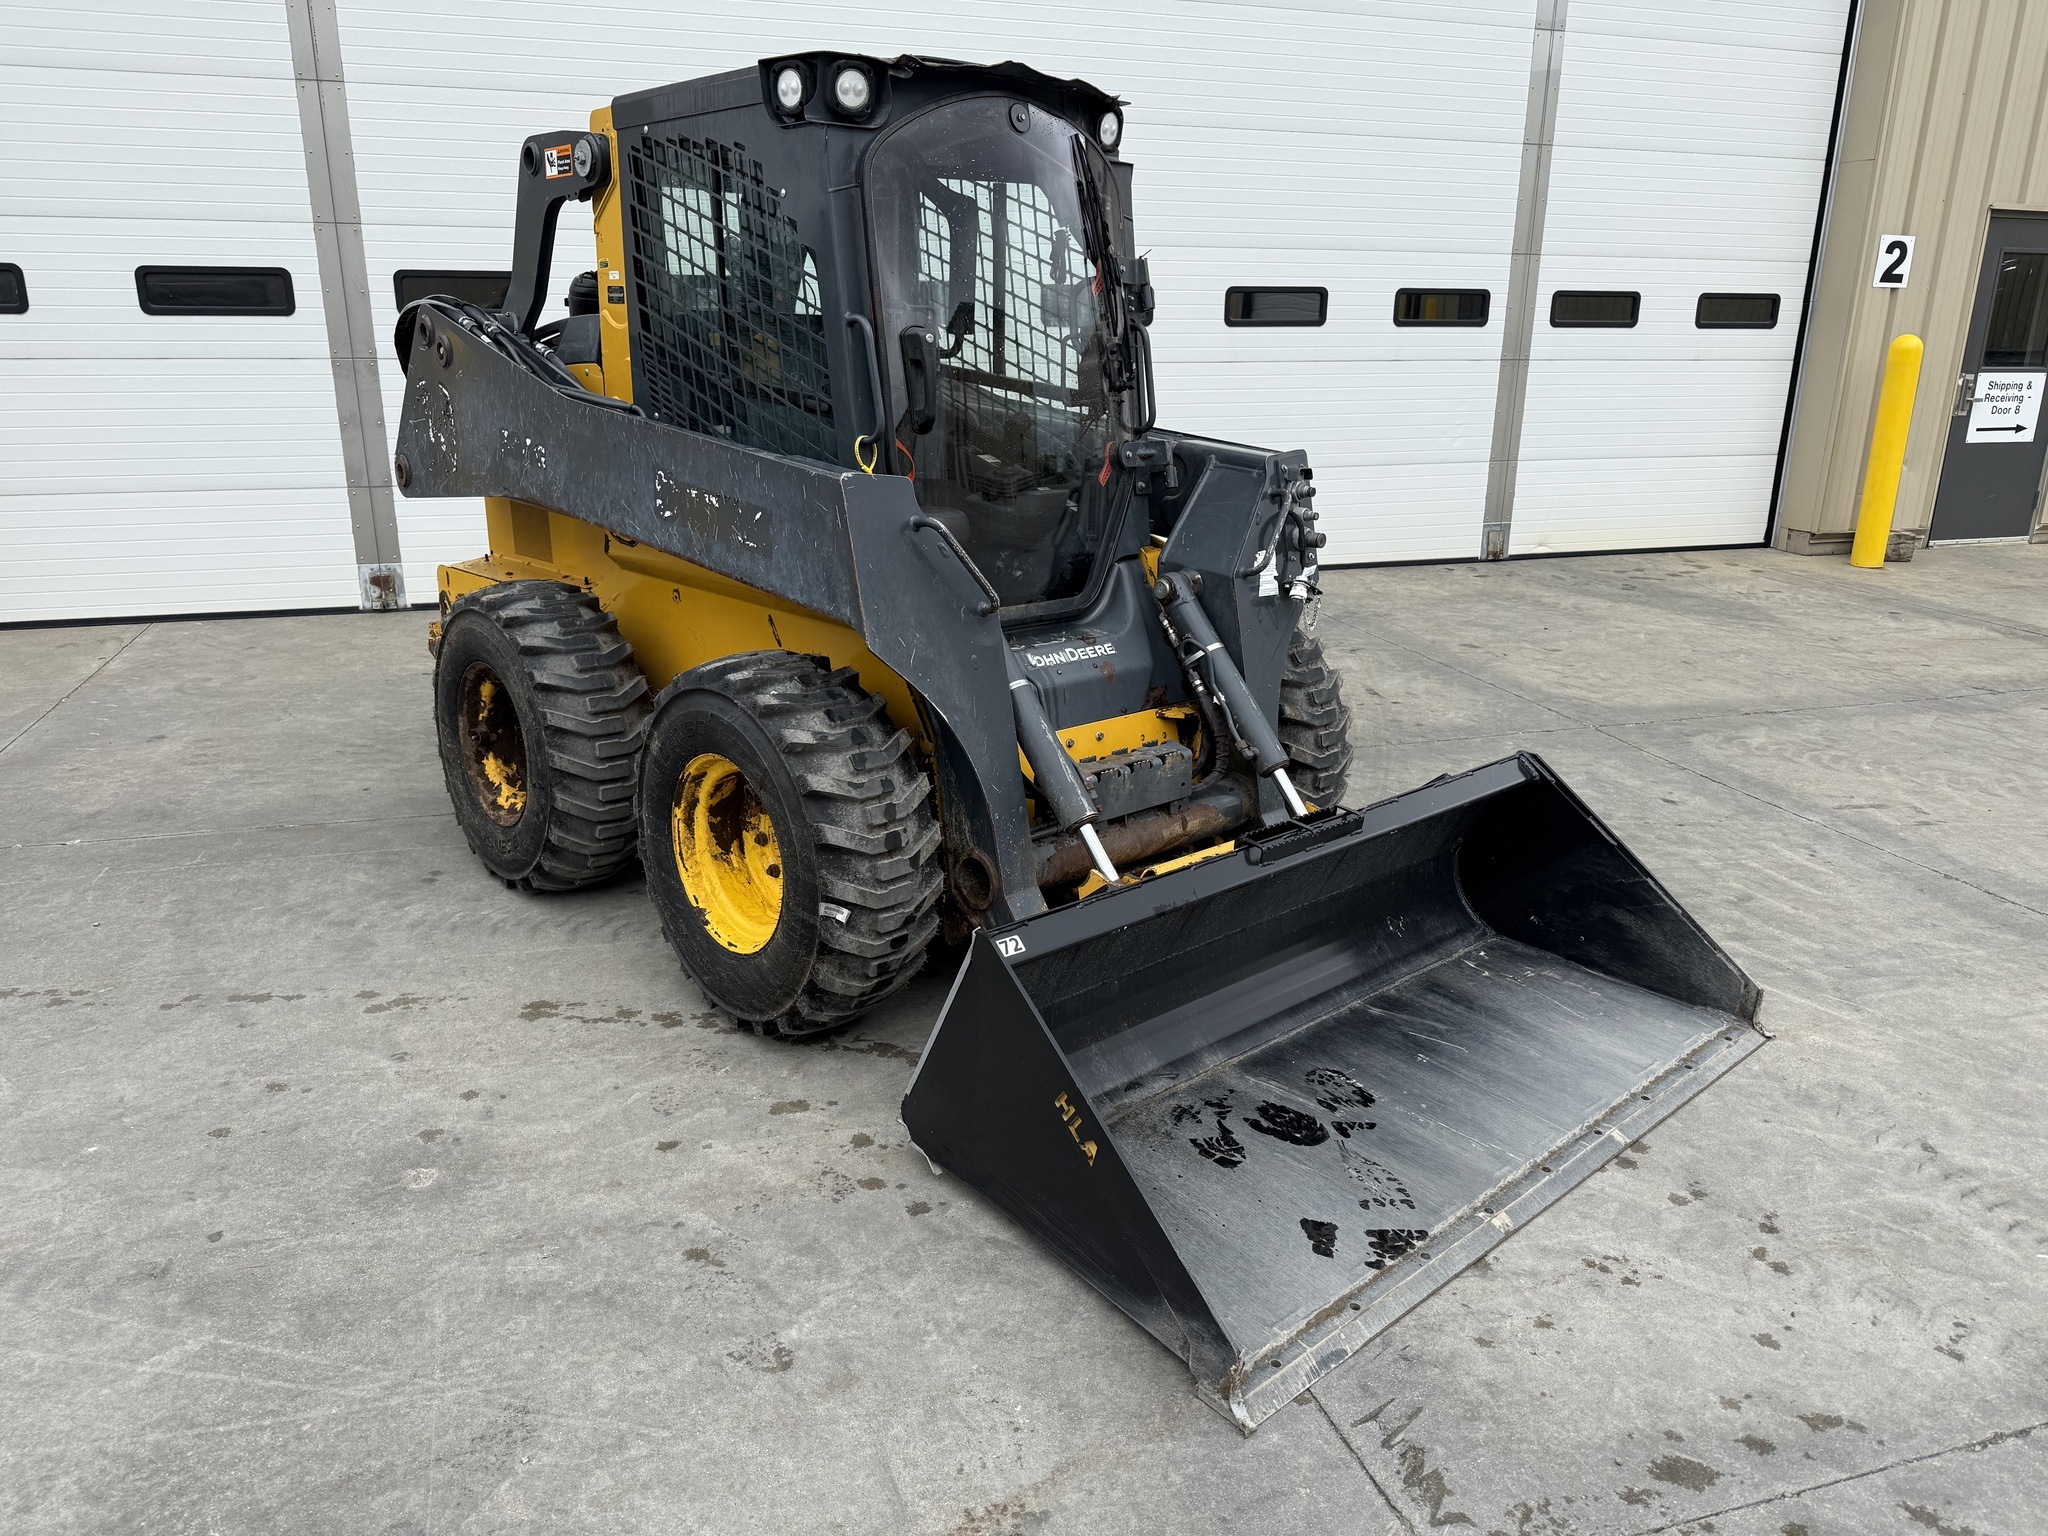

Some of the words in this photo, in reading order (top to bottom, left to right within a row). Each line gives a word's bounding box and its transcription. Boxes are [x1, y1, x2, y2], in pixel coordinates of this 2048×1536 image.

[1879, 240, 1908, 283] 2
[1987, 380, 2023, 392] Shipping
[2026, 380, 2032, 390] &
[1984, 392, 2024, 404] Receiving
[1991, 405, 2011, 414] Door
[2014, 405, 2020, 414] 8
[1064, 643, 1116, 662] DEERE
[998, 937, 1022, 955] 72
[1054, 1091, 1098, 1167] HLA
